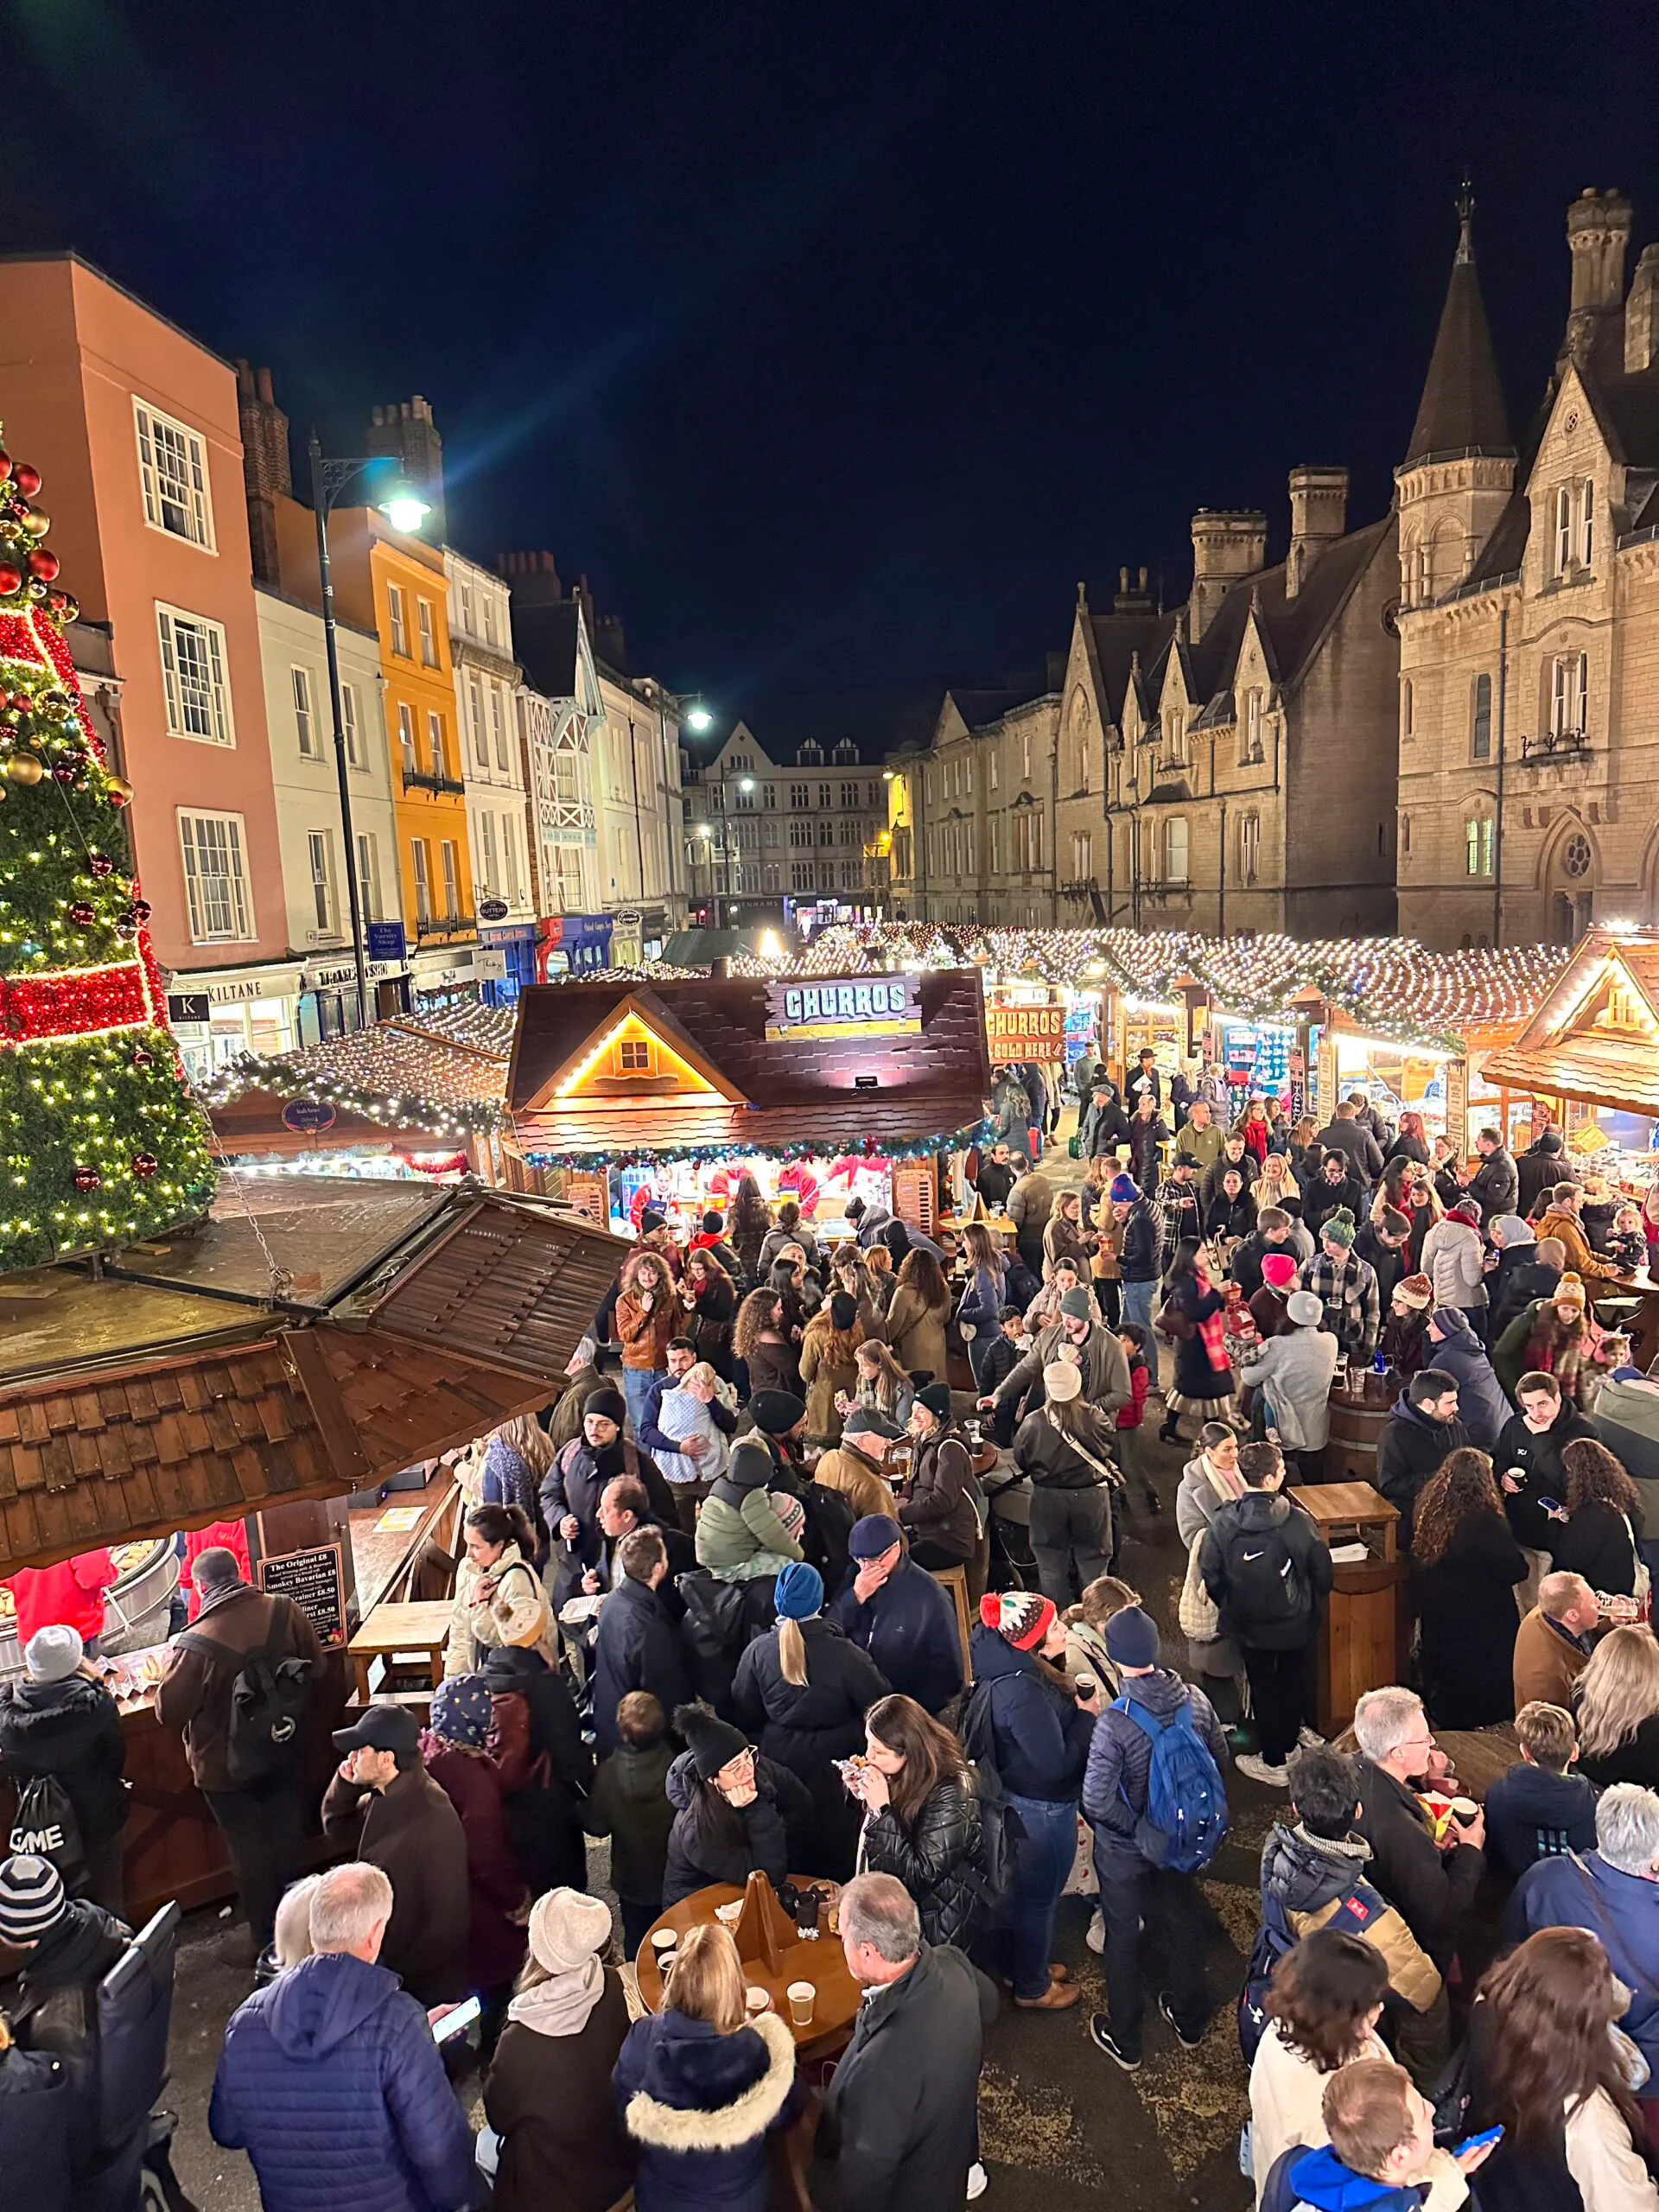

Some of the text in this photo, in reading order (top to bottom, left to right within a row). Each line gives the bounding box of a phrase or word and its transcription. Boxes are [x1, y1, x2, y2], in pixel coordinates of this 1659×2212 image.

[207, 982, 262, 1002] KILTANE
[181, 997, 195, 1014] K
[785, 983, 906, 1023] CHURROS
[985, 1010, 1061, 1038] CHURROS
[994, 1041, 1052, 1059] SOLD HERE
[286, 1555, 317, 1567] Original
[318, 1553, 327, 1561] £8
[266, 1580, 293, 1591] Smokey
[295, 1572, 327, 1584] Bavarian
[294, 1592, 315, 1601] rainer
[317, 1586, 335, 1596] £8.50
[317, 1605, 335, 1616] £8.50
[10, 1824, 64, 1853] GAME
